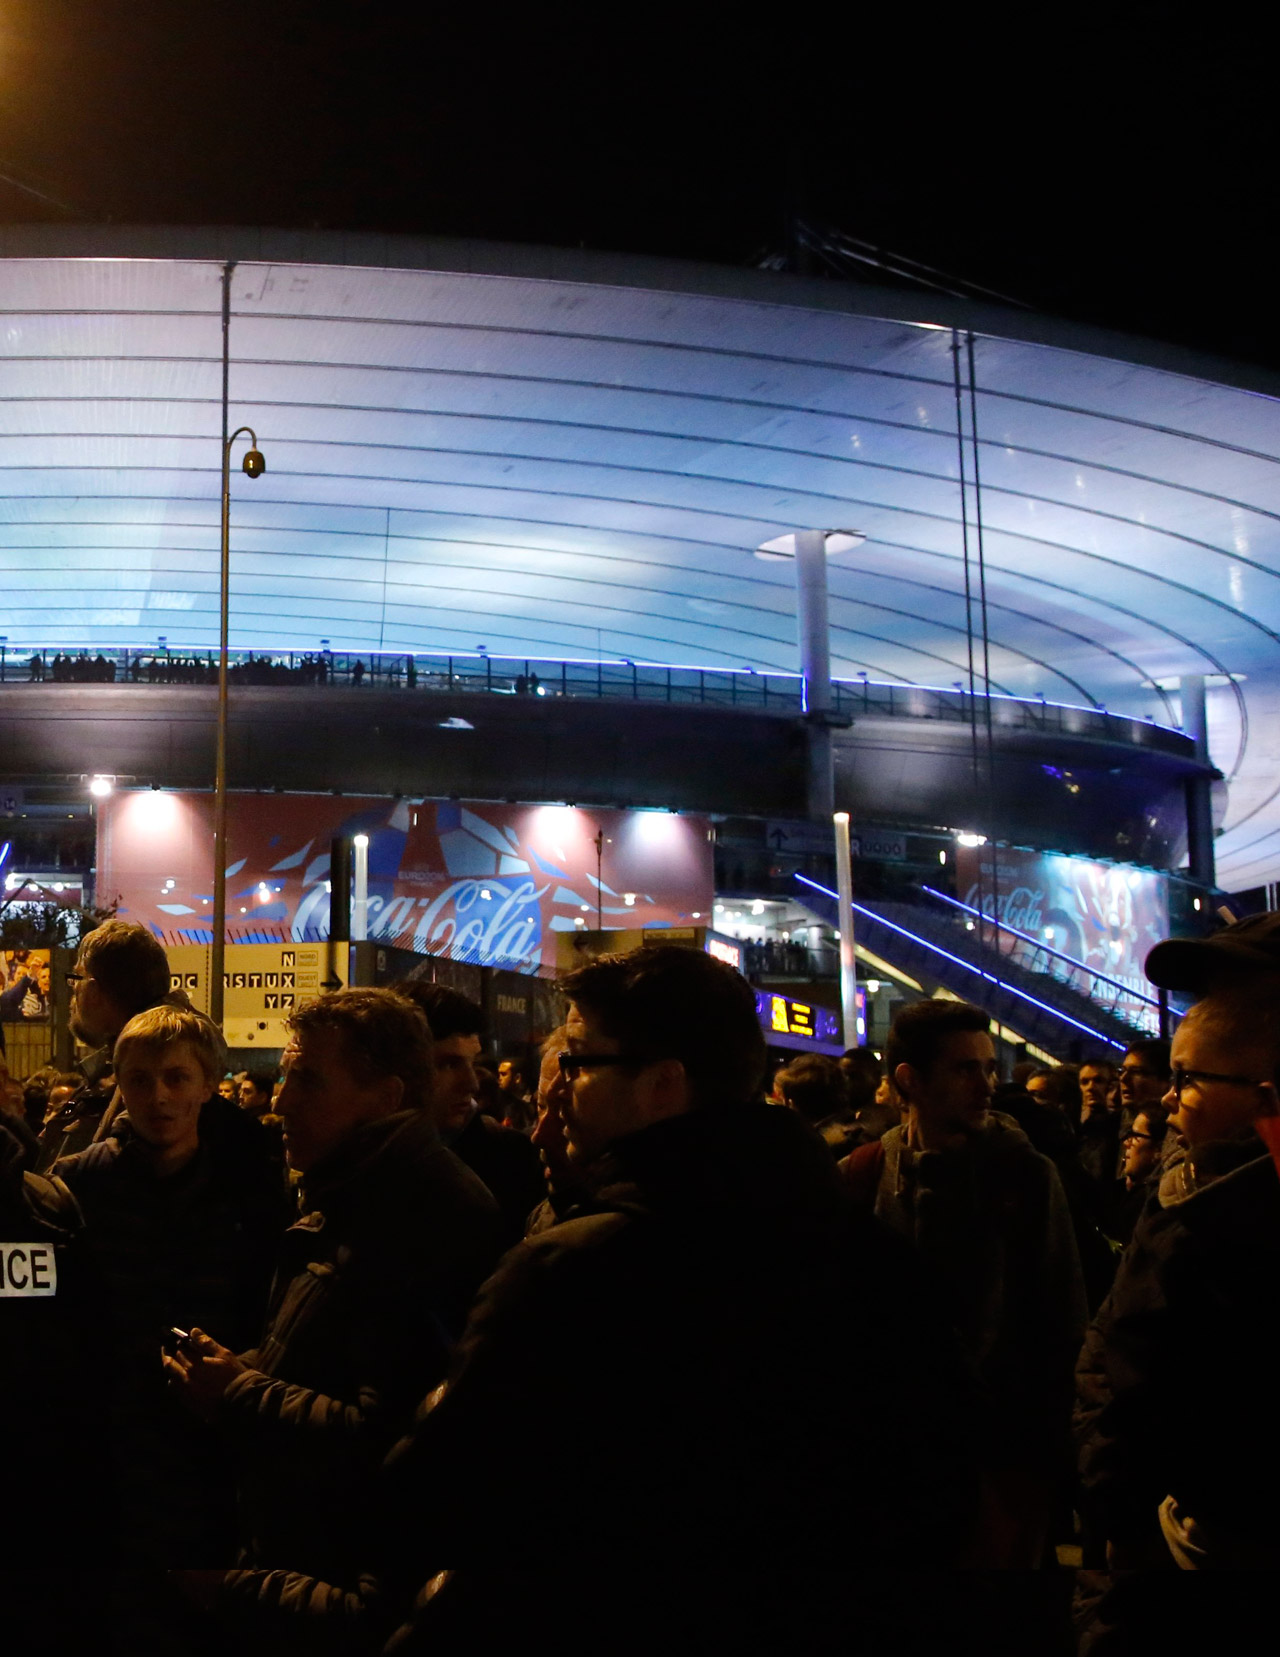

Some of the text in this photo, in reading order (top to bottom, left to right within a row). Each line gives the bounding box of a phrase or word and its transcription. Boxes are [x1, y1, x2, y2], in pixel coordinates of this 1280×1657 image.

[291, 879, 552, 963] Cca-Cola
[283, 954, 294, 967] N
[171, 976, 196, 988] D C
[234, 975, 245, 988] S
[250, 975, 260, 988] T
[266, 975, 277, 988] U
[283, 974, 294, 988] X
[266, 996, 277, 1009] Y
[283, 996, 293, 1009] Z
